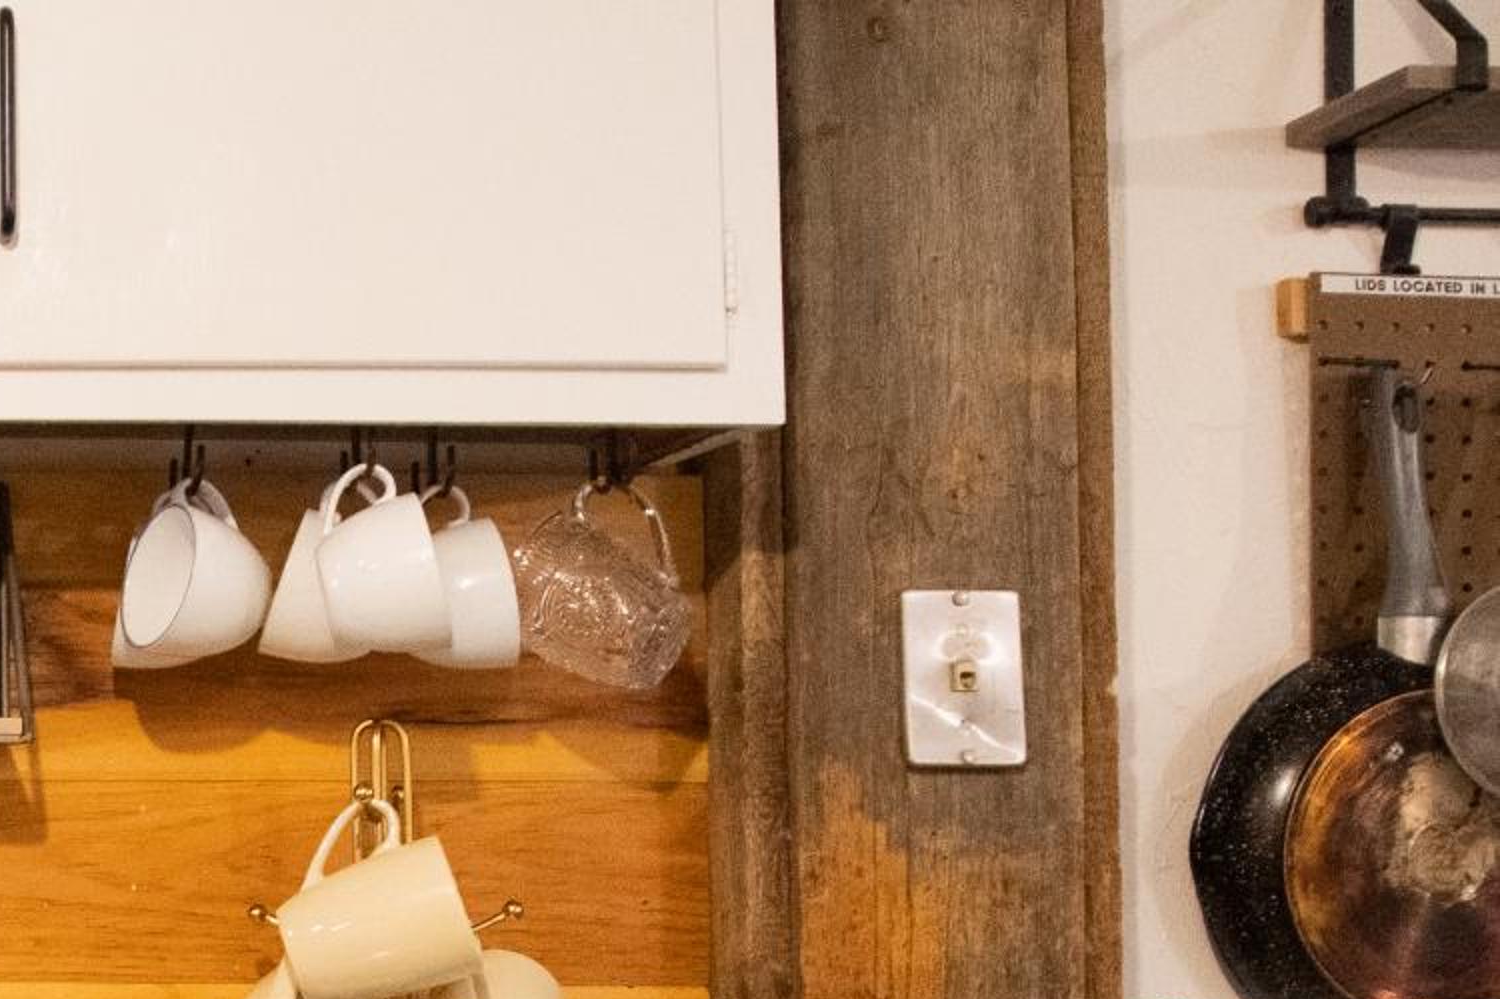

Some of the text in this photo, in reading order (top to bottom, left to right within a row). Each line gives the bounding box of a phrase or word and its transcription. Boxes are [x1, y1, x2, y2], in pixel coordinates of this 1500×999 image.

[1355, 277, 1386, 292] LIDS
[1394, 279, 1463, 294] LOCATED
[1469, 281, 1486, 295] IN
